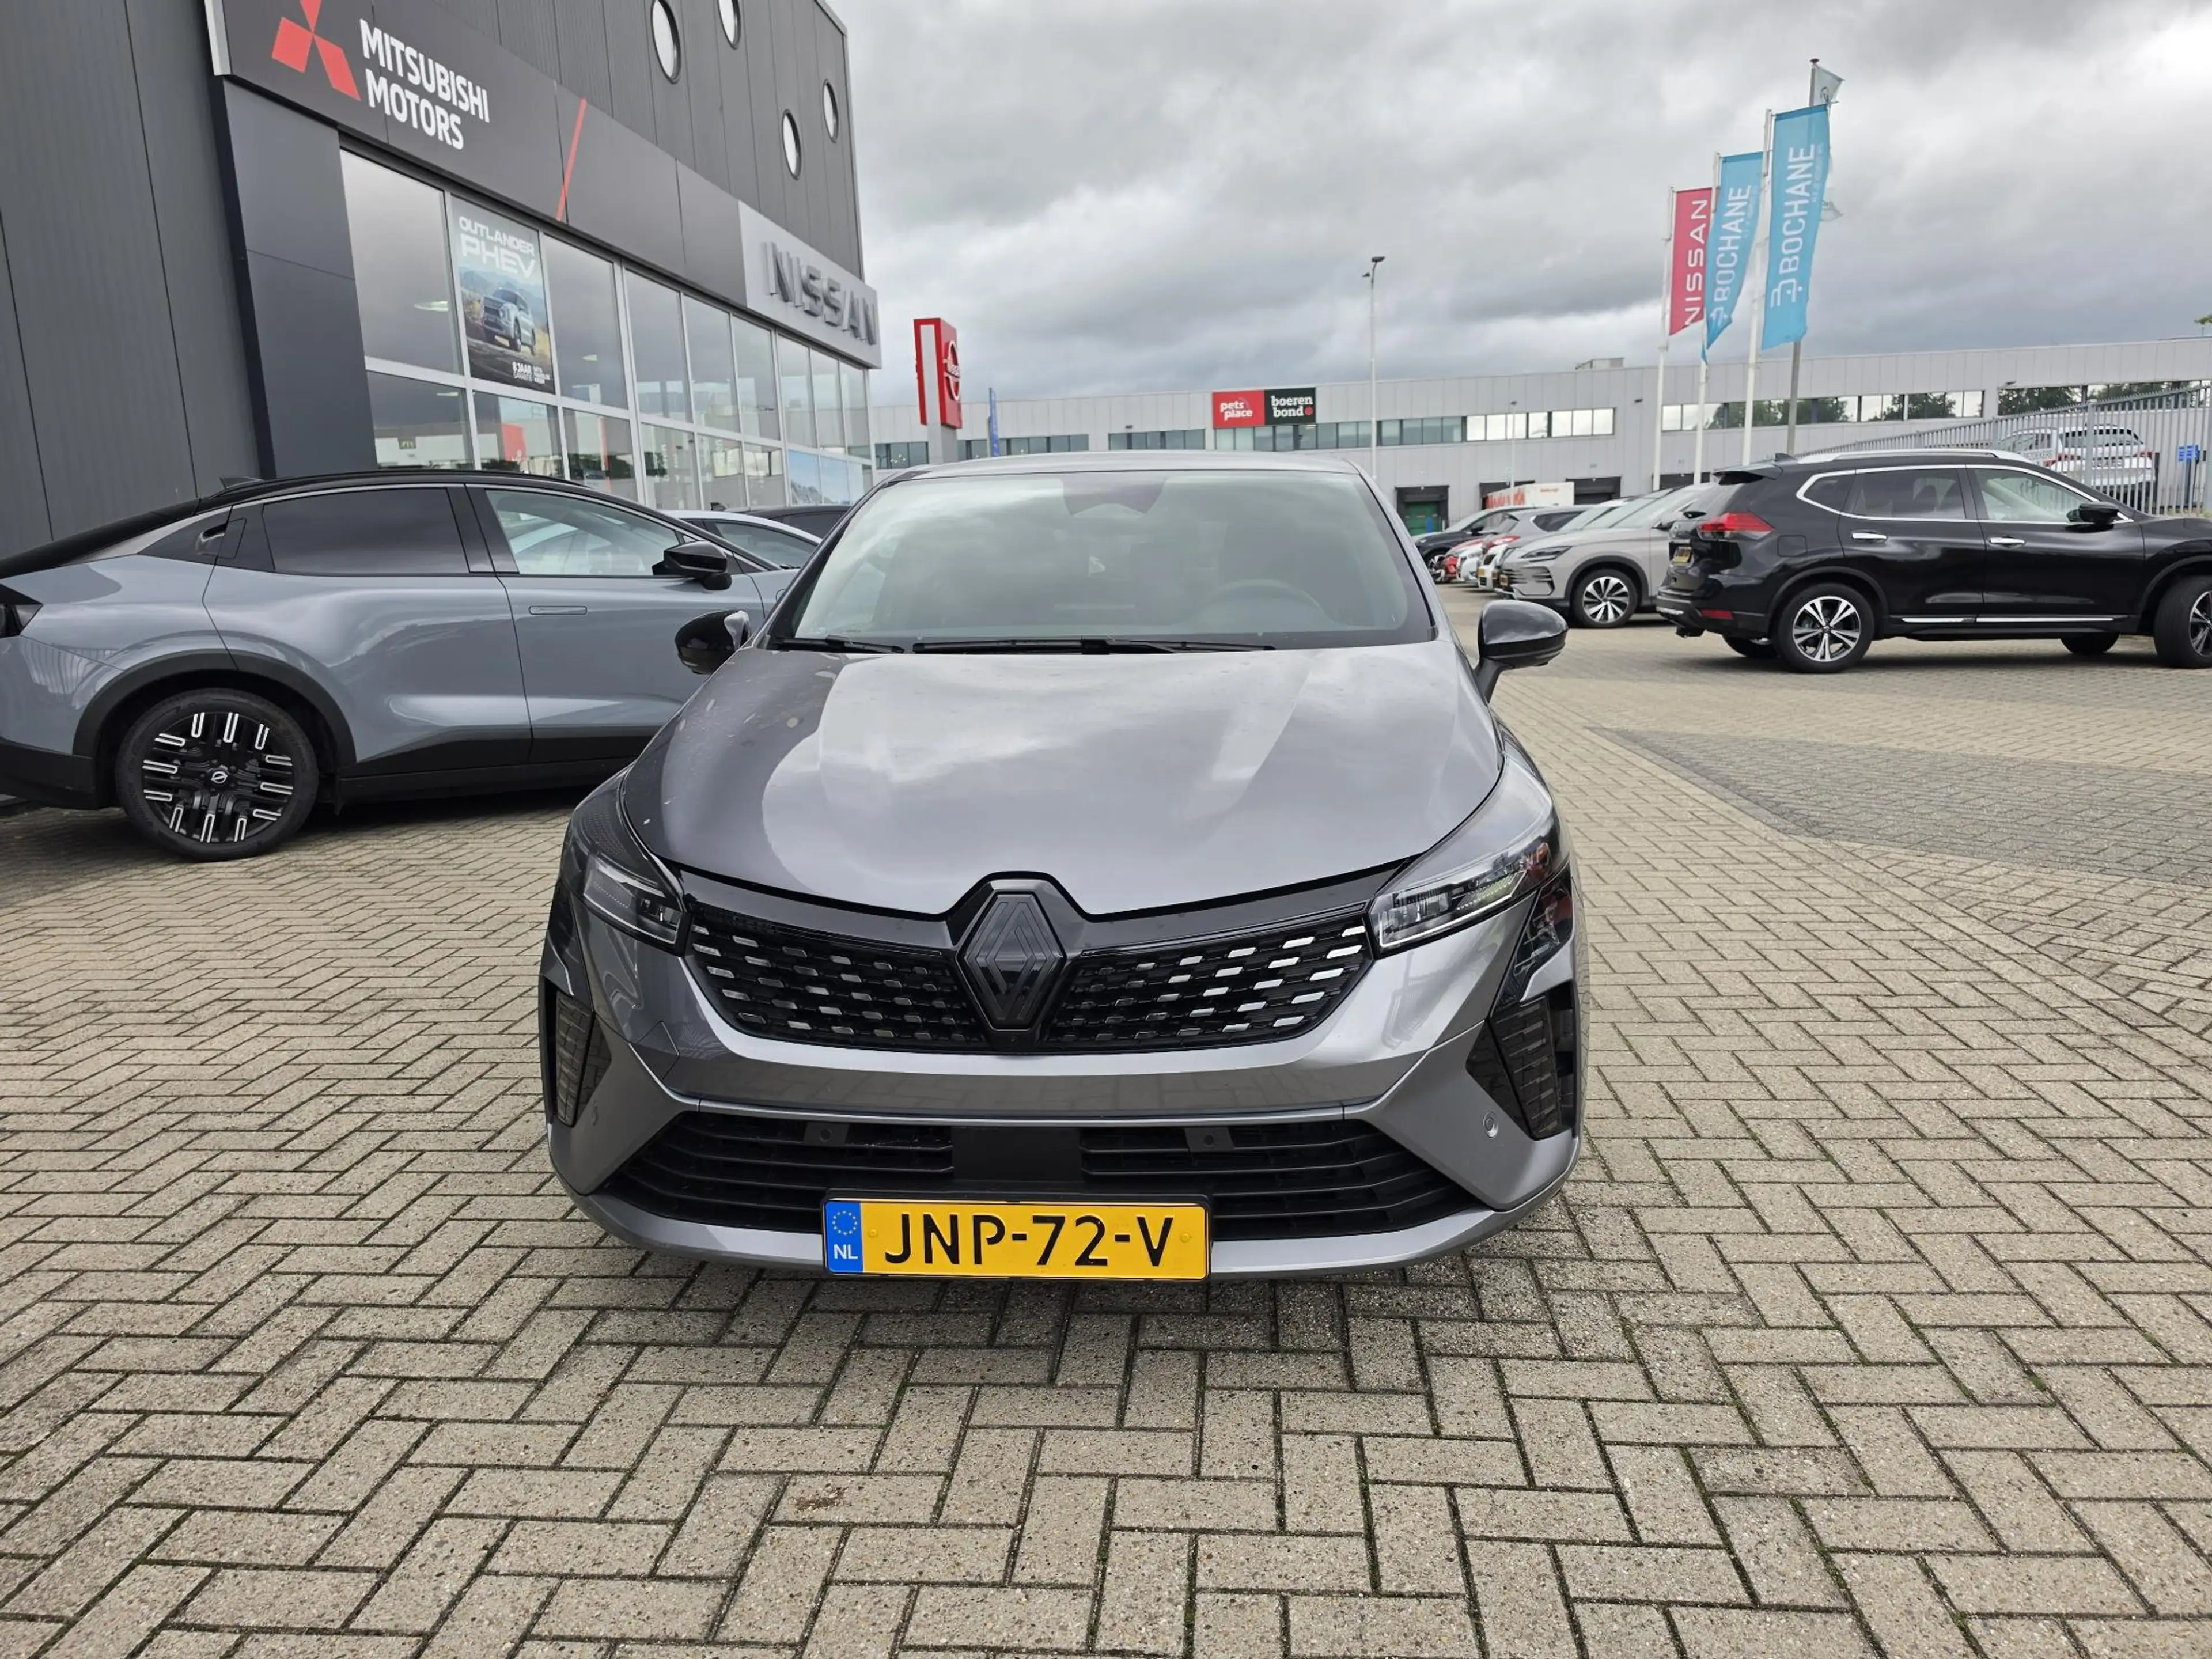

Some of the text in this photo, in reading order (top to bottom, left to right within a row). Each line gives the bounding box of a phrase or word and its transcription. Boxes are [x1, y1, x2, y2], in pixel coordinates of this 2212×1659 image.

[360, 18, 490, 123] MITSUBISHI
[365, 69, 464, 150] MOTORS
[1779, 144, 1815, 274] BOCHANE
[459, 216, 535, 256] OUTLANDER
[460, 233, 535, 278] PHEV
[1714, 185, 1752, 301] BOCHANE
[1684, 199, 1708, 326] NISSAN
[761, 241, 877, 346] NISSAN
[1220, 400, 1244, 412] pets
[1224, 408, 1253, 421] place
[1271, 395, 1313, 406] boeren
[1272, 406, 1304, 418] bond
[834, 1244, 858, 1260] NL
[885, 1214, 1174, 1267] JNP-72-V
